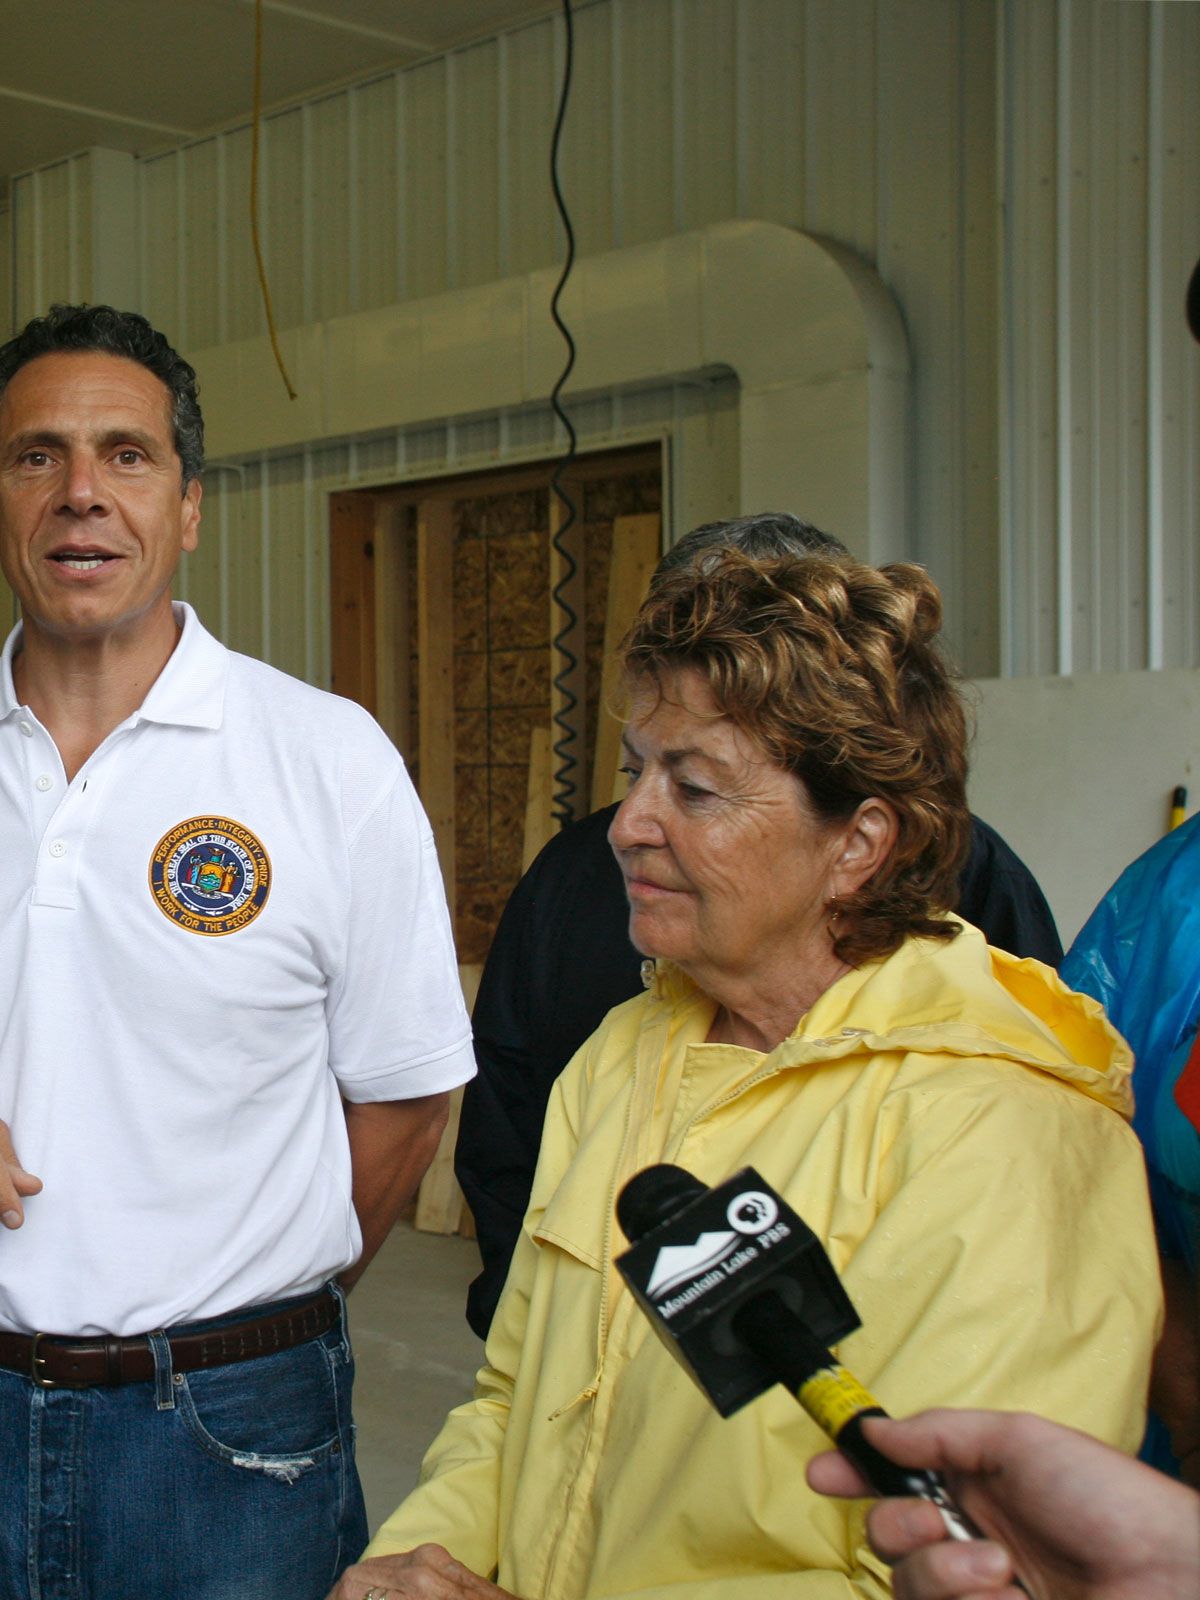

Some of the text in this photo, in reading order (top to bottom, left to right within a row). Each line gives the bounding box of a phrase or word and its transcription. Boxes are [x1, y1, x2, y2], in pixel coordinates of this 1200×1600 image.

[155, 819, 268, 887] PERFORMANCE INTEGRITY PRIDE
[167, 834, 255, 911] THE GREAT SEAL OF THE STATE OF NEW YORK
[156, 888, 180, 916] WORK
[179, 914, 200, 929] FOR
[203, 922, 223, 932] THE
[225, 903, 260, 930] PEOPLE
[657, 1222, 791, 1319] Mountain Lake PBS
